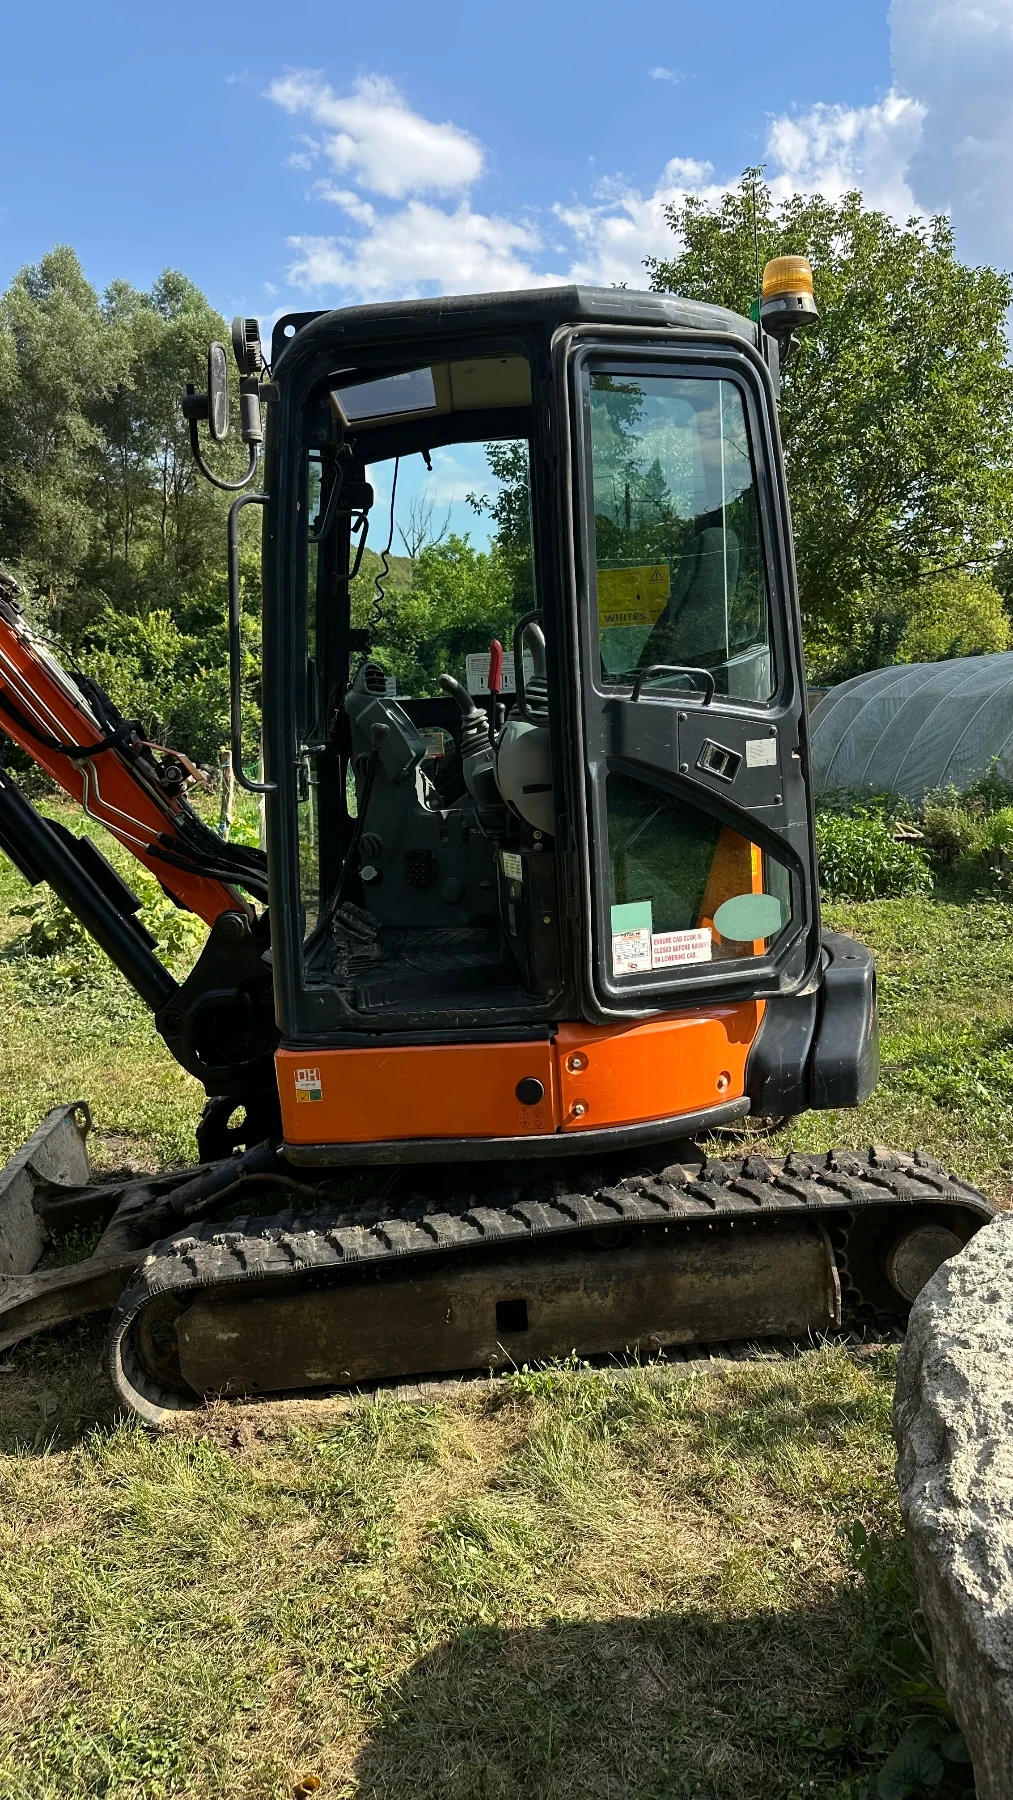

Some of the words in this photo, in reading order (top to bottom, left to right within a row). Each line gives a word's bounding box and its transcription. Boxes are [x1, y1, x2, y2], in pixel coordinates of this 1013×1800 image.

[605, 613, 646, 622] WHITES
[654, 937, 672, 946] ENSURE
[673, 935, 683, 943] CAB
[684, 934, 696, 942] DOOR
[654, 946, 671, 954] CLOSED
[673, 943, 691, 952] BEFORE
[655, 956, 661, 964] OR
[662, 953, 686, 963] LOWERING
